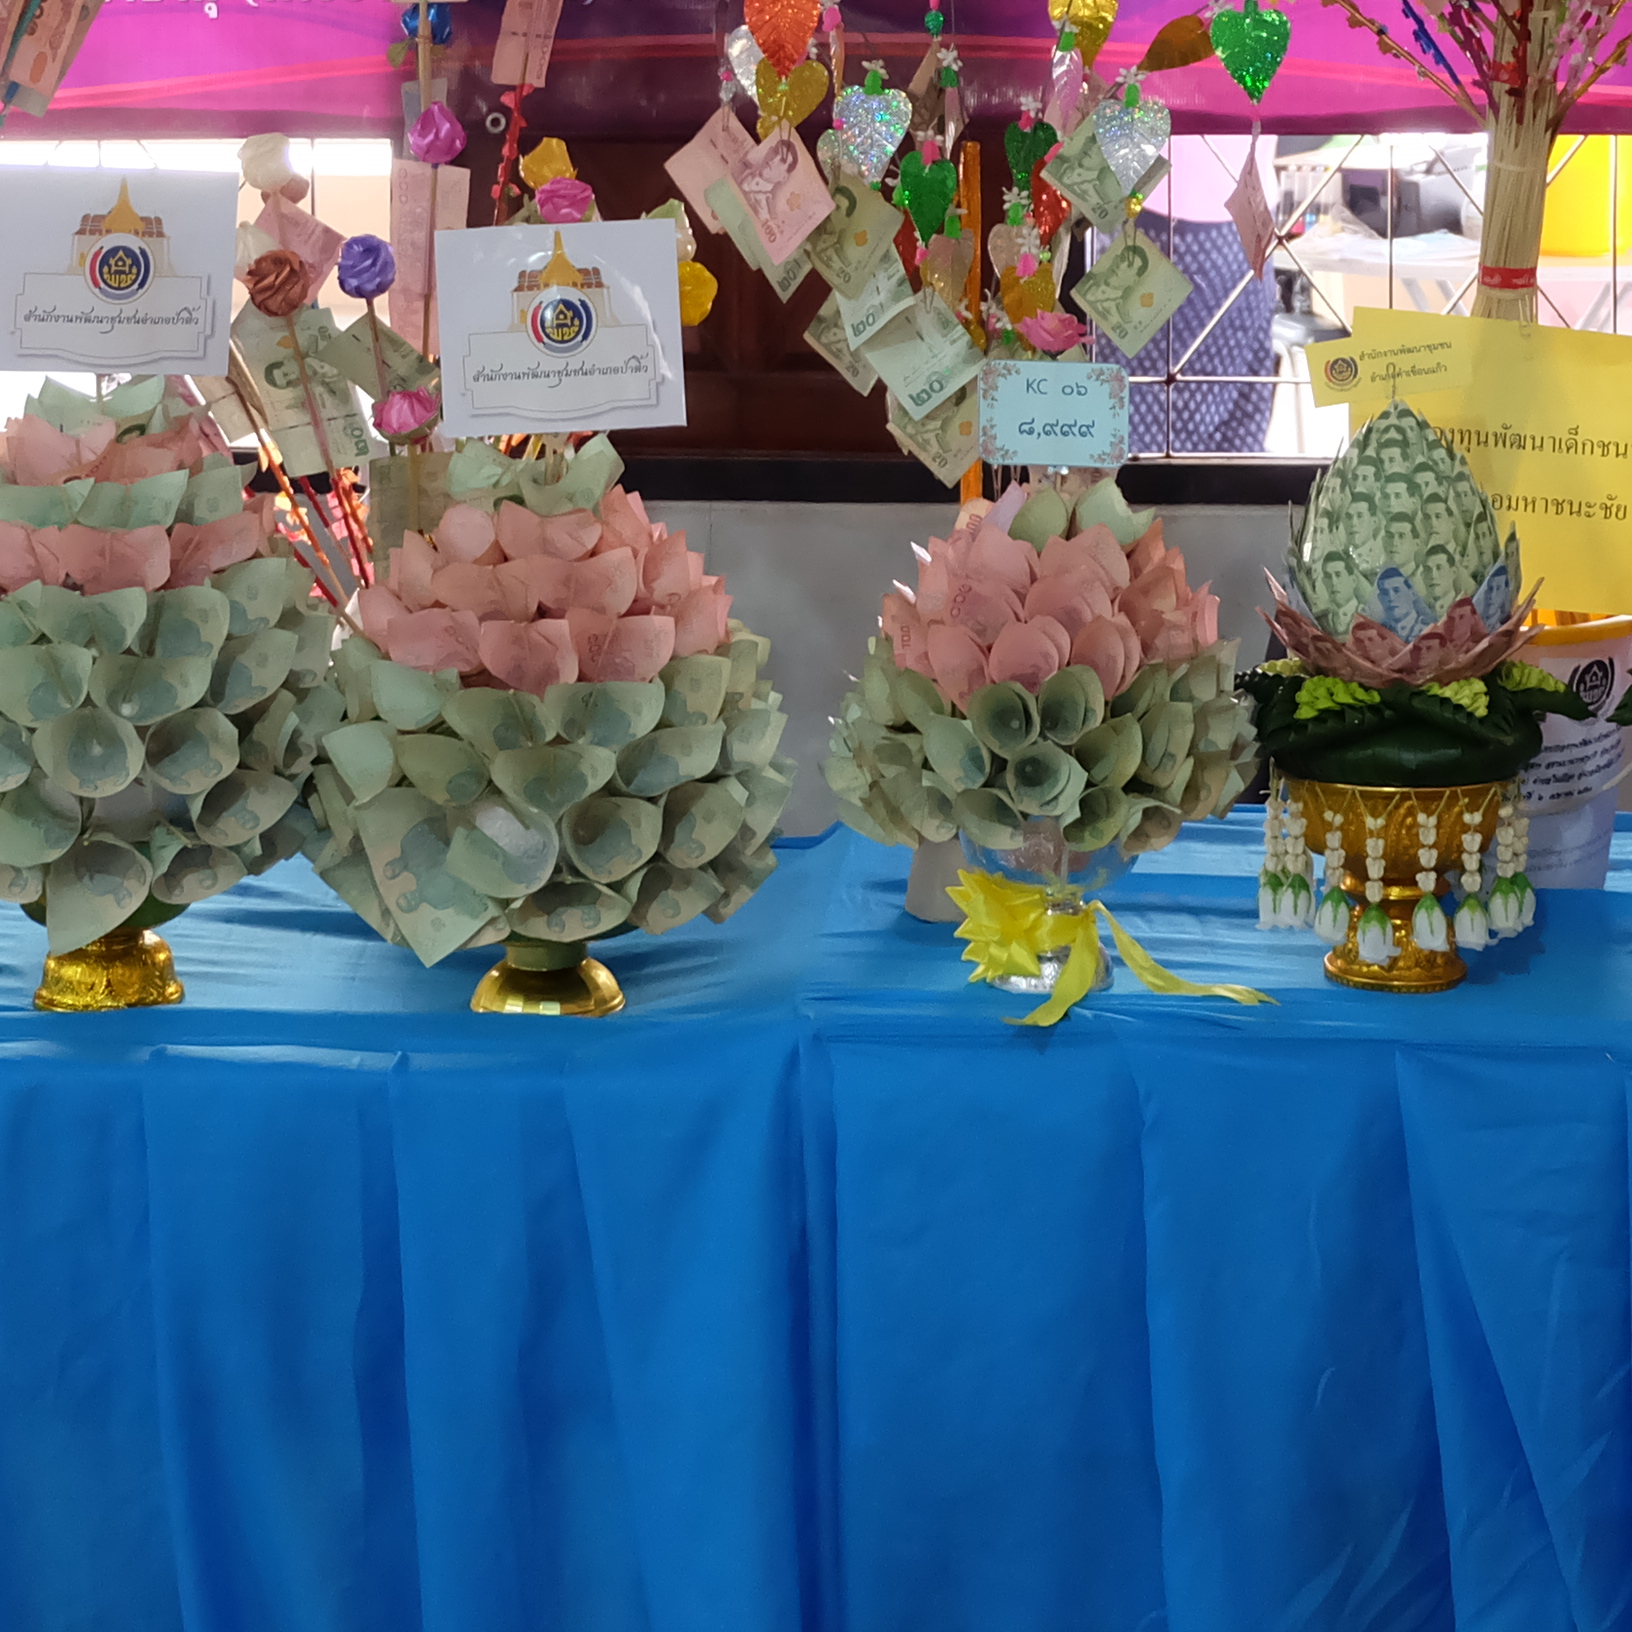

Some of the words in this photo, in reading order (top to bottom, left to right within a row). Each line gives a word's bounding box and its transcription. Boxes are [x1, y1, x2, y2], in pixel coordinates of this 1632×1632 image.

[1025, 378, 1048, 396] KC
[1490, 493, 1628, 521] อมหาชนะชัย
